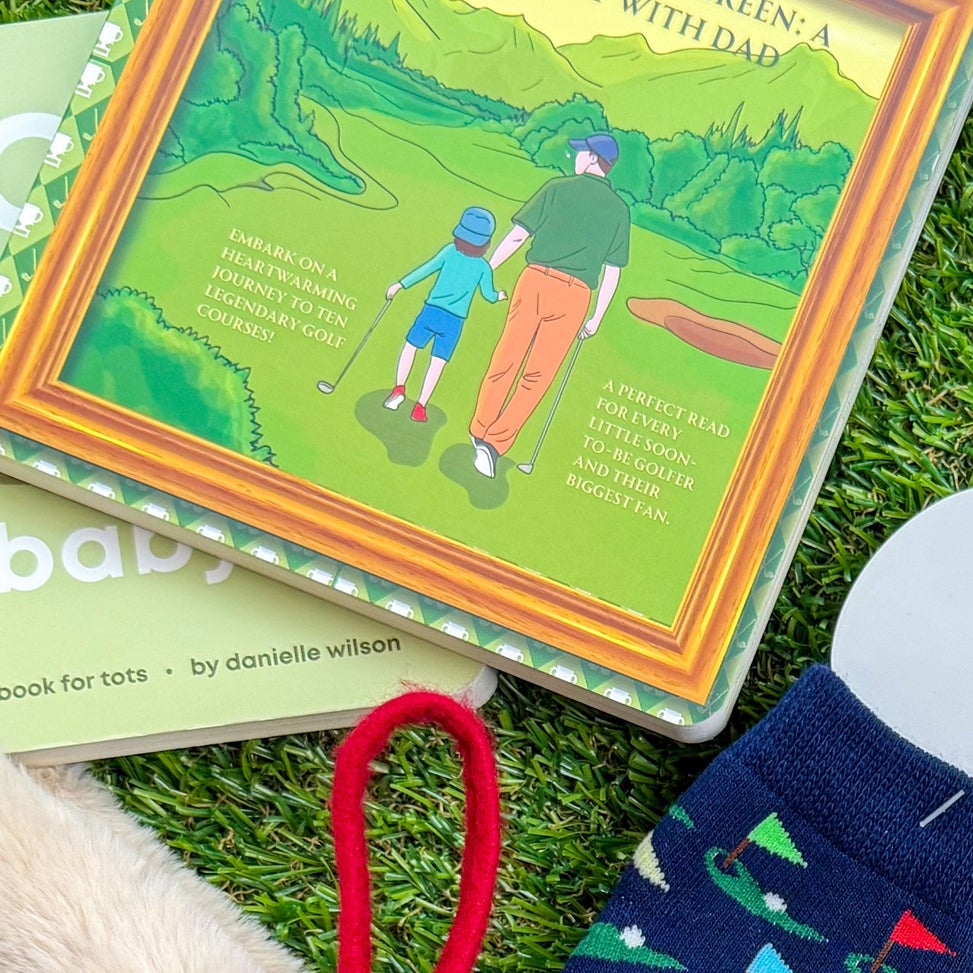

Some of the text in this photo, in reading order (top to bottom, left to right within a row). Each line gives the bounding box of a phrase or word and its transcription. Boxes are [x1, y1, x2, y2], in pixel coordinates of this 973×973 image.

[710, 24, 781, 68] DAD
[811, 23, 831, 48] A
[221, 247, 358, 311] HEARTWARMING
[229, 228, 338, 282] EMBARK ON A
[196, 303, 276, 343] COURSES!
[205, 284, 347, 349] LEGENDARY GOLF
[212, 265, 349, 328] JOURNEY TO TEN
[596, 397, 684, 441] FOR EVERY
[602, 379, 731, 439] A PERFECT READ
[588, 416, 697, 467] LITTLE SOON-
[565, 473, 671, 526] BIGGEST FAN.
[573, 455, 661, 499] AND THEIR
[634, 457, 696, 492] GOLFER
[0, 521, 234, 593] bab
[60, 674, 95, 692] for
[100, 667, 148, 687] tots
[190, 657, 220, 678] by
[225, 644, 321, 672] danielle
[326, 636, 402, 659] wilson
